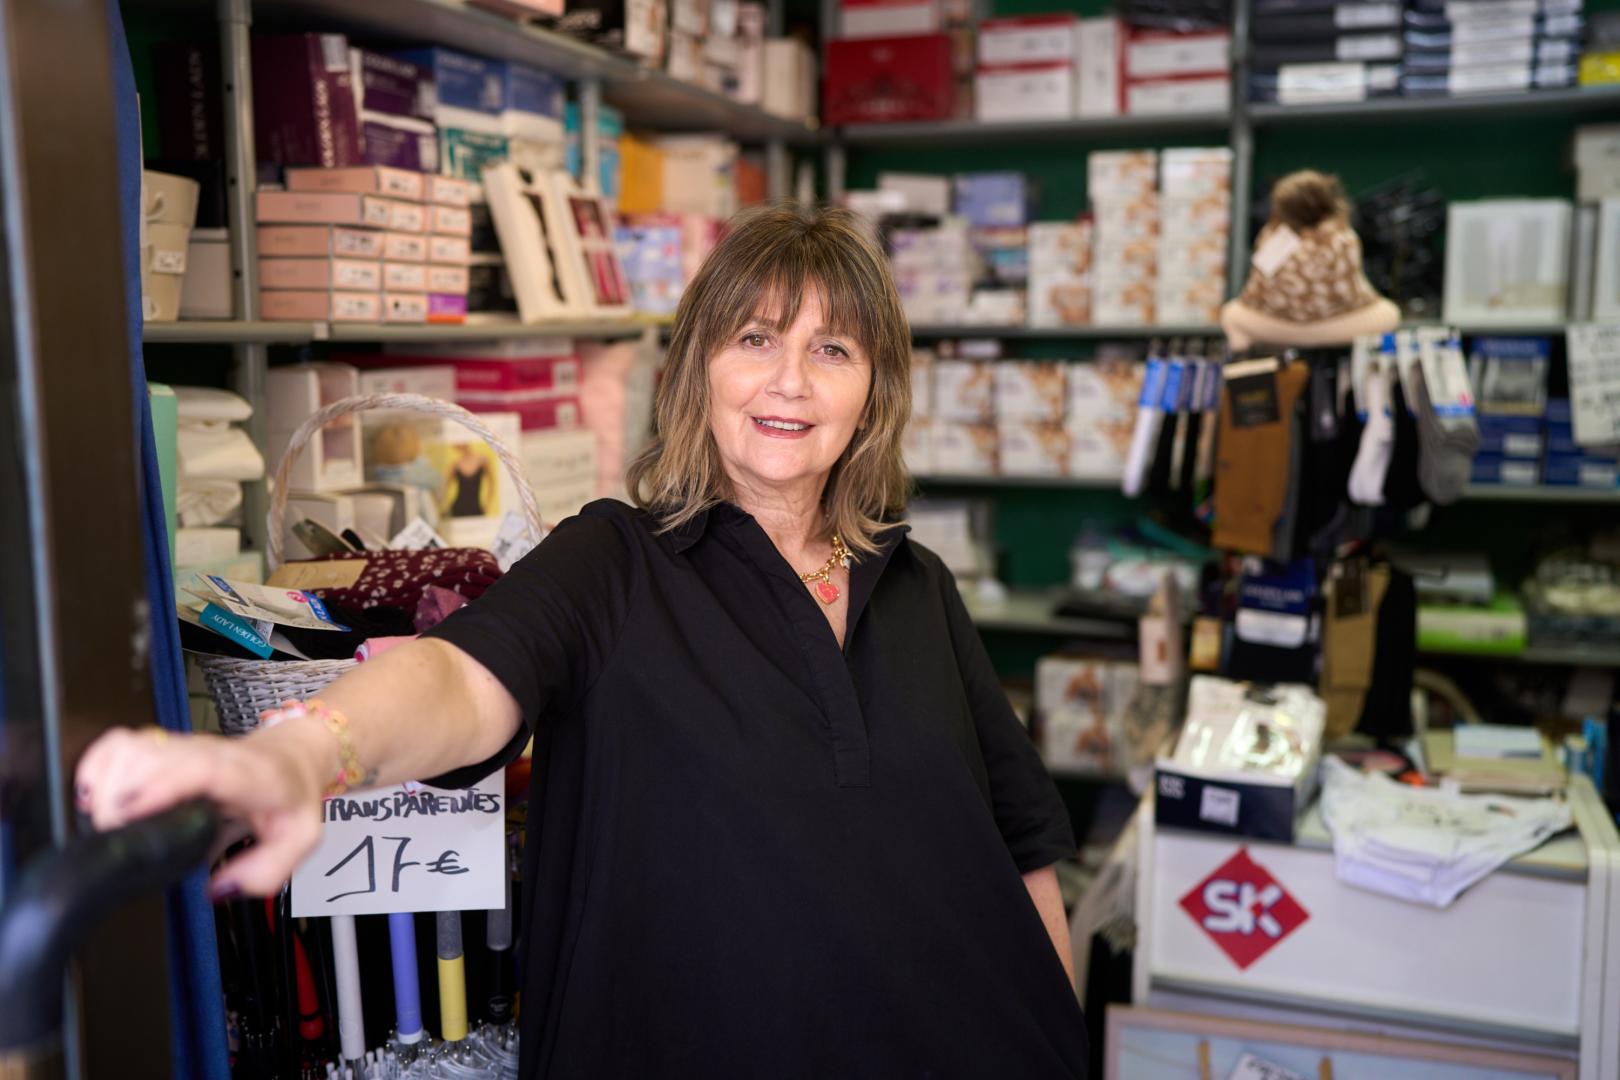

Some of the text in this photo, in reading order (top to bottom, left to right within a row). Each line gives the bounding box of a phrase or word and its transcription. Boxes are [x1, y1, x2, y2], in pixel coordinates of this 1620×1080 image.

[213, 613, 266, 648] GOLDEN LADY
[1204, 879, 1282, 937] SK
